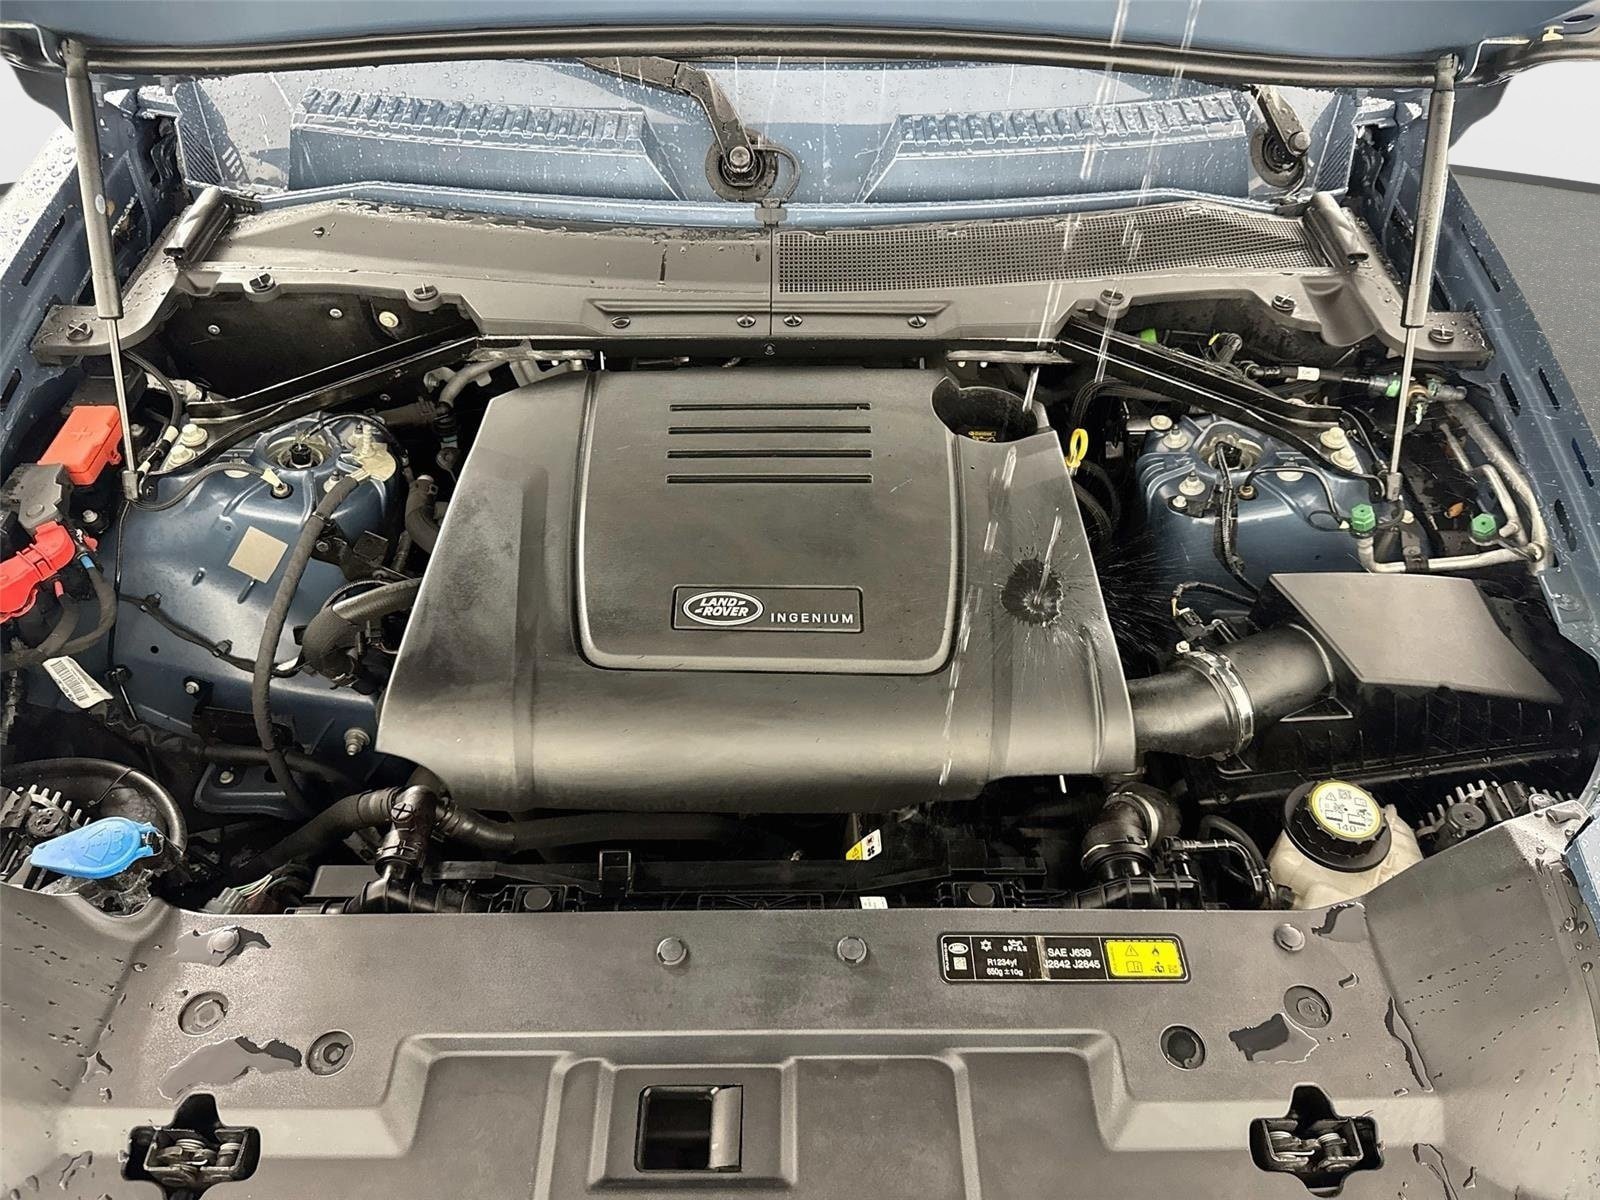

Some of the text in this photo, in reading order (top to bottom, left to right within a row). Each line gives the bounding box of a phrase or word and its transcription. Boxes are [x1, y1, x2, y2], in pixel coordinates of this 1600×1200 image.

[699, 597, 737, 607] LAND
[701, 606, 749, 617] ROVER
[770, 612, 854, 624] INGENIUM
[1337, 823, 1356, 832] 140
[1047, 948, 1092, 958] SAE J639
[1043, 959, 1101, 969] J2842 J2845
[986, 968, 1004, 977] 650g
